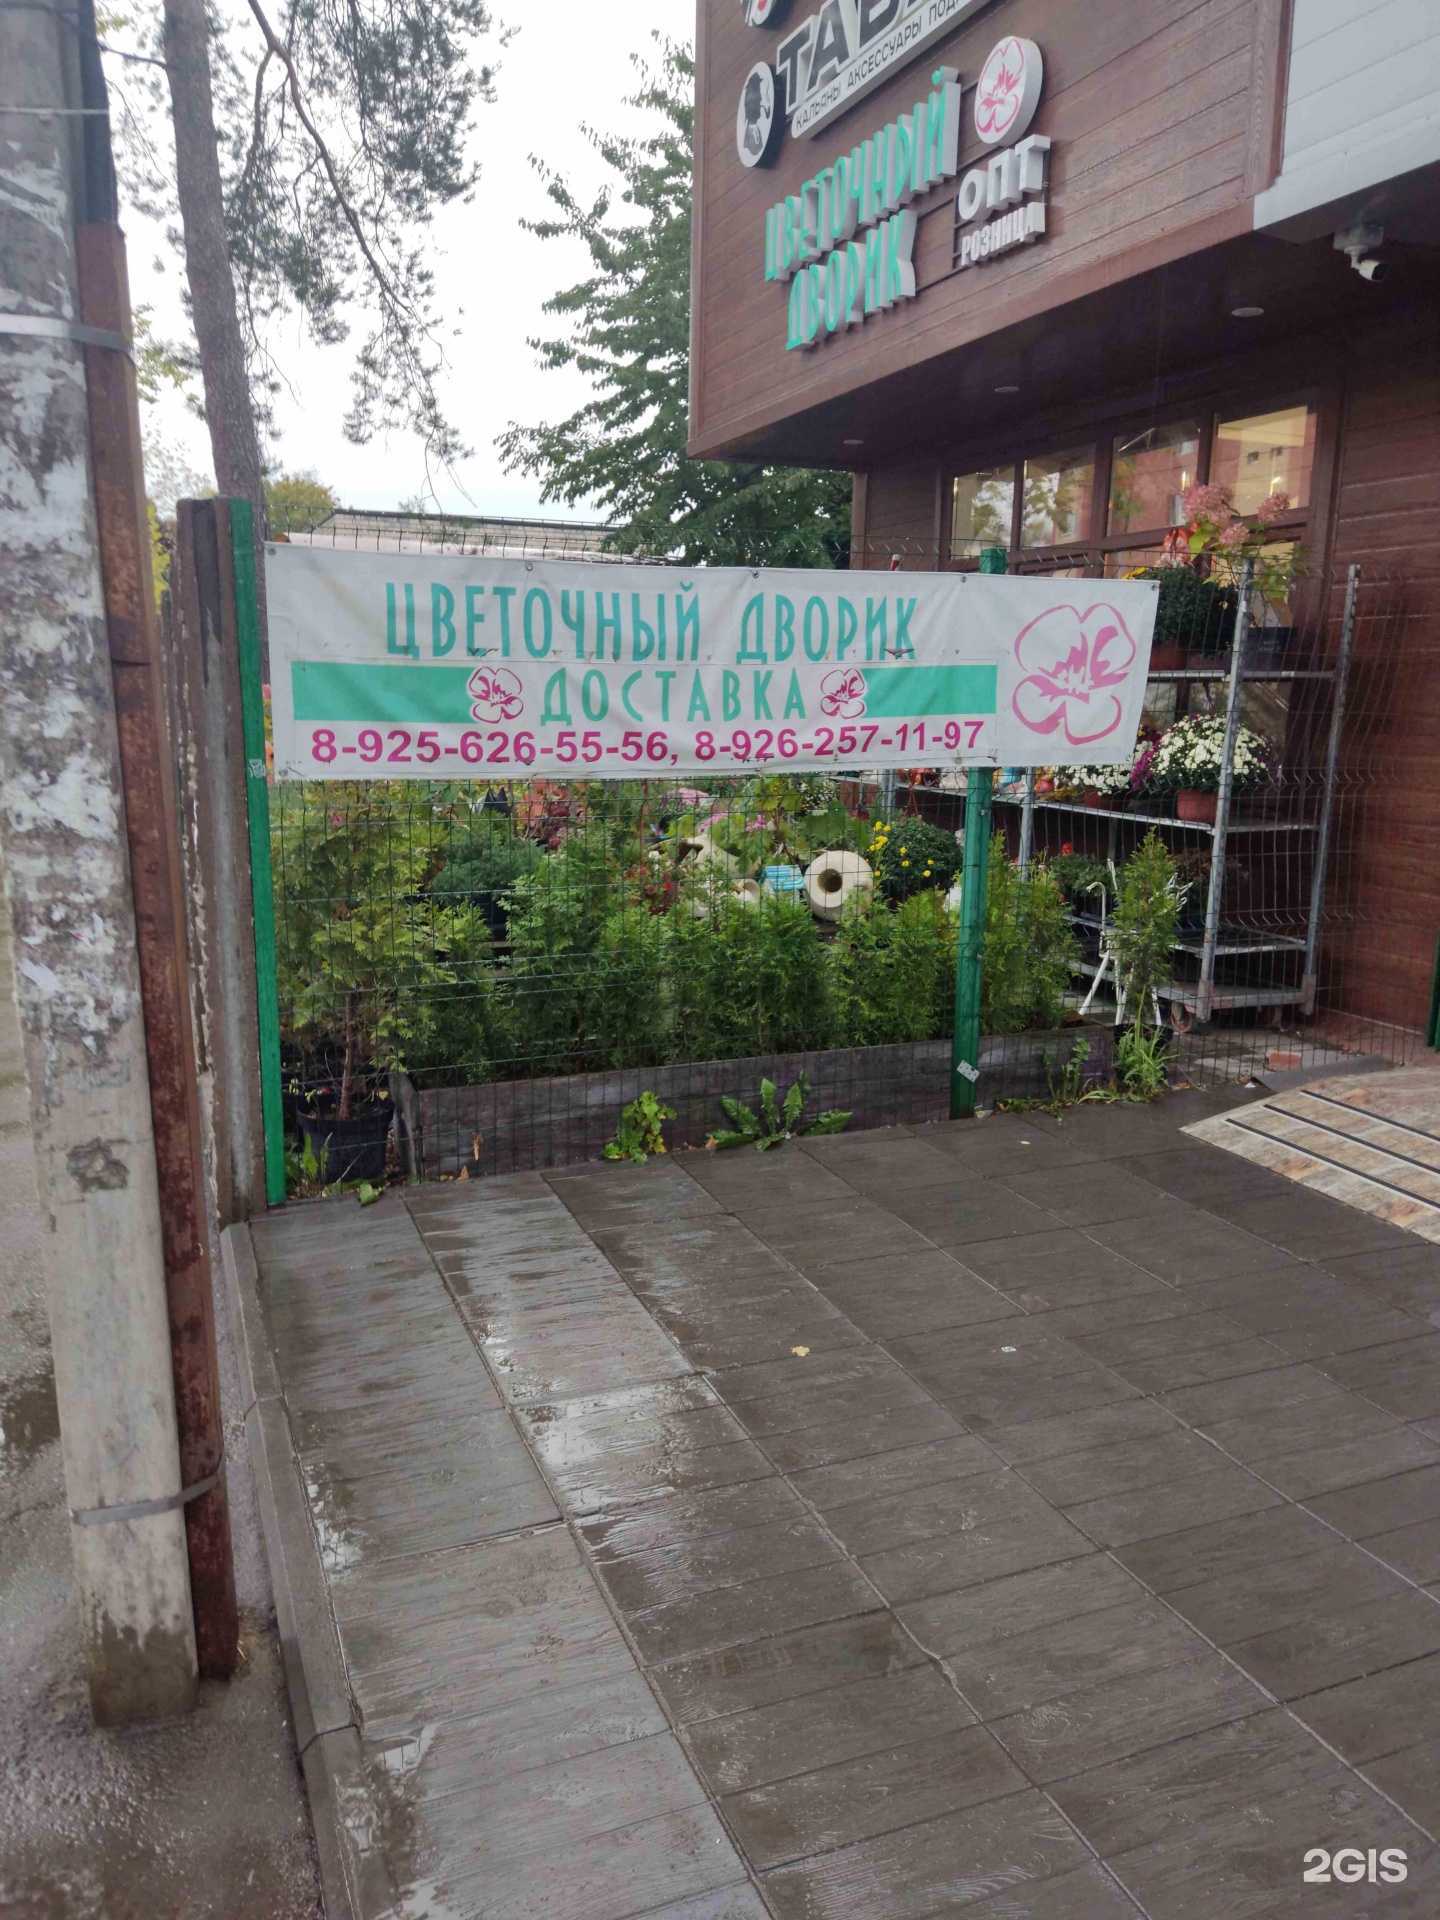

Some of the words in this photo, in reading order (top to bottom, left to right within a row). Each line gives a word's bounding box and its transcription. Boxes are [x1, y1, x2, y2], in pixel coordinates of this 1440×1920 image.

[848, 15, 921, 87] АКСЕССУАРЫ
[928, 0, 959, 25] ПОД
[958, 134, 1051, 221] ОПТ
[961, 202, 1046, 267] РОЗНИЦА
[785, 209, 917, 350] ДВОРИК
[386, 581, 700, 662] ЦВЕТОЧНЫЙ
[736, 592, 918, 664] ДВОРИК
[541, 667, 806, 726] ДОСТАВКА
[311, 728, 678, 766] 8-925-626-55-56,
[694, 721, 984, 761] 8-926-257-11-97
